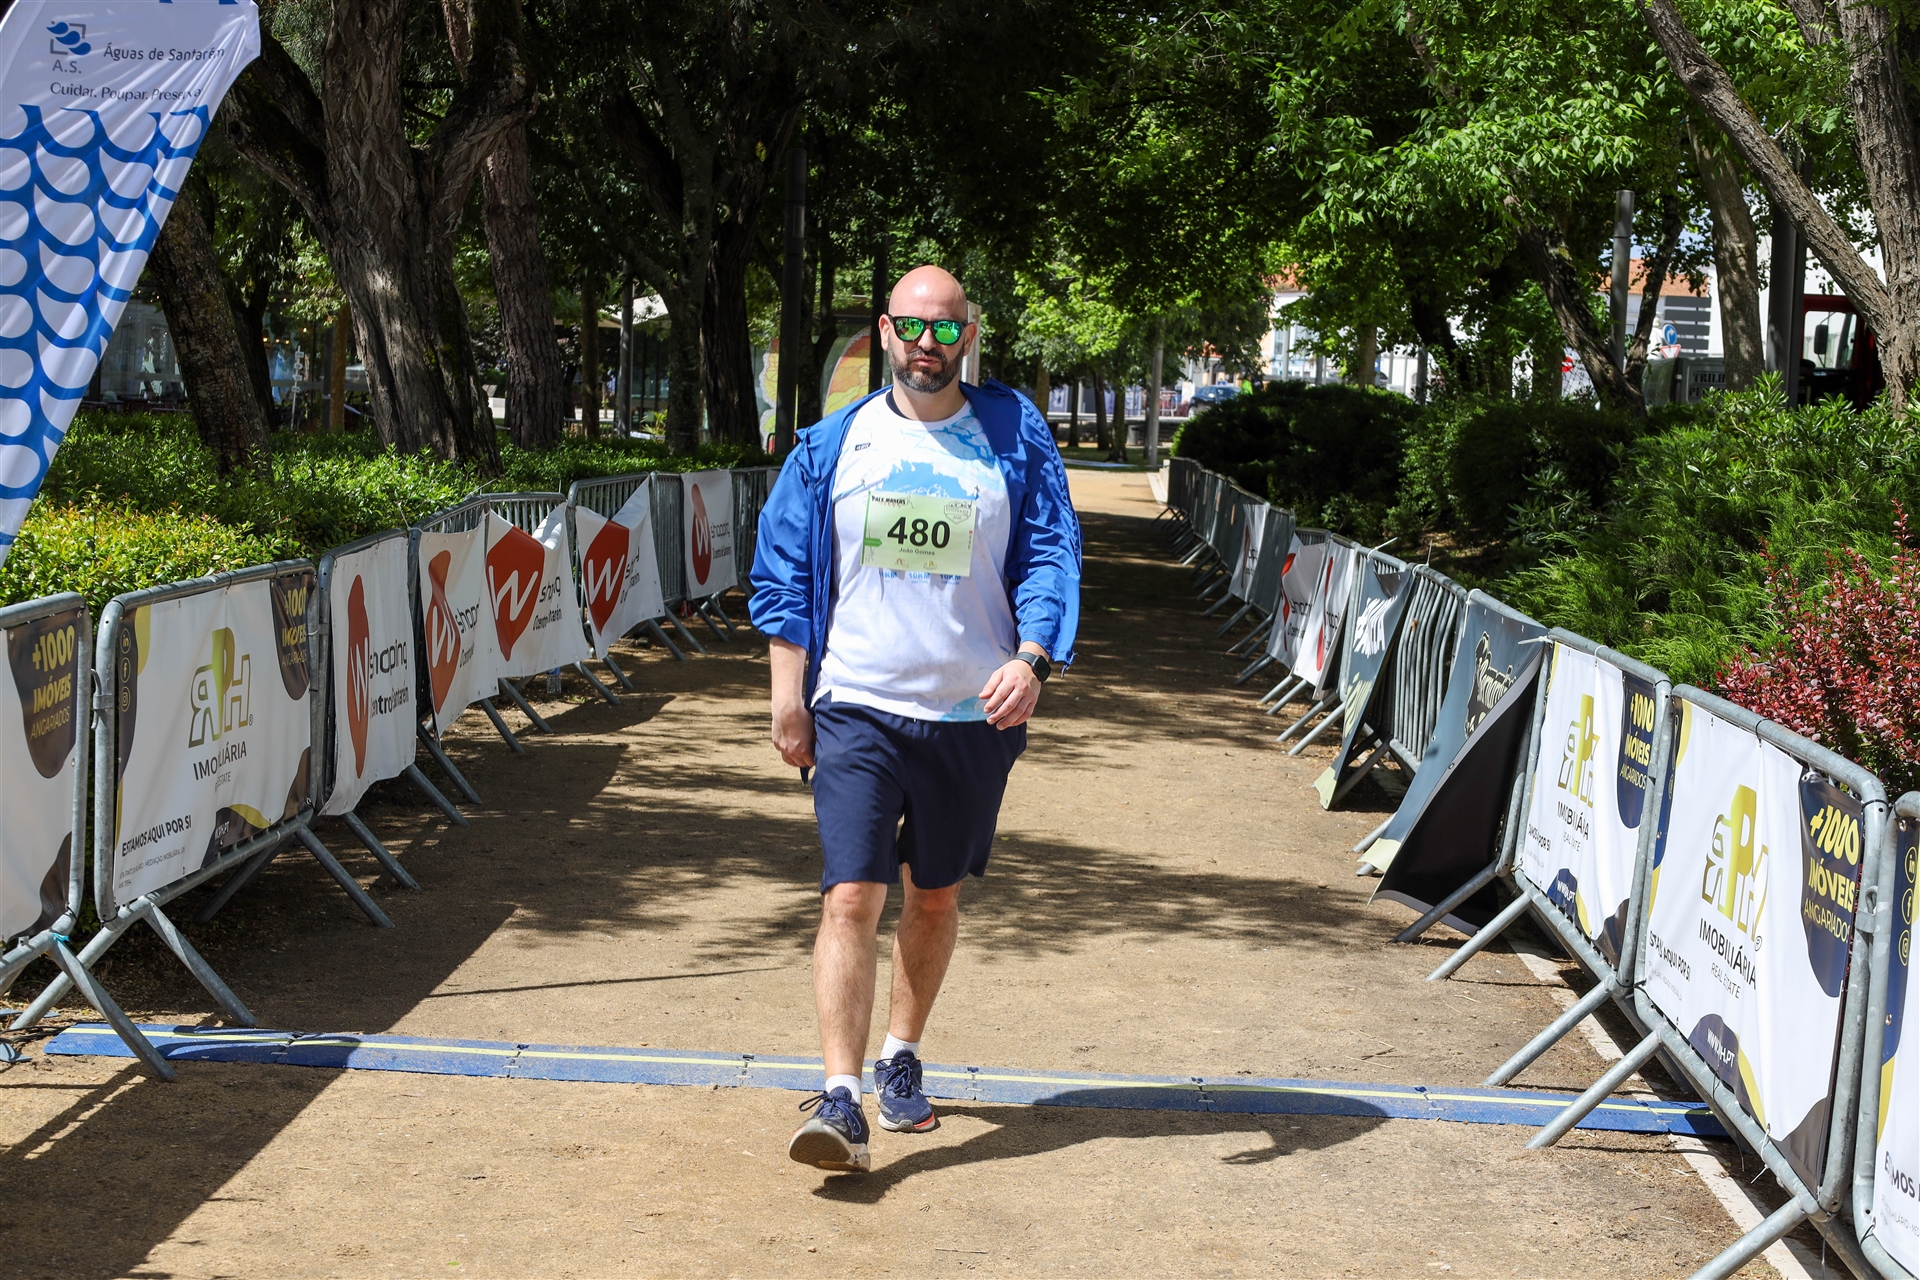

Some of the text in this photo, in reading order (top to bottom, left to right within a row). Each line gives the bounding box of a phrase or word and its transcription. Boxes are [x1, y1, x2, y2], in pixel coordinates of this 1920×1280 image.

[52, 59, 82, 74] A.S.
[103, 42, 144, 61] Águas
[148, 47, 164, 60] de
[50, 82, 97, 99] Cuidar.
[101, 86, 149, 101] Poupar.
[887, 516, 951, 549] 480
[899, 547, 935, 556] João Gomes
[488, 565, 539, 622] W
[588, 554, 626, 605] W
[32, 625, 75, 672] +1000
[33, 673, 71, 714] IMÓVEIS
[30, 706, 70, 740] ANGARIADOS
[122, 815, 192, 857] ESTAMOS AQUI POR SI
[1810, 804, 1860, 866] +1000
[1808, 857, 1856, 914] IMÓVEIS
[1699, 918, 1757, 991] IMOBILIÁRIA
